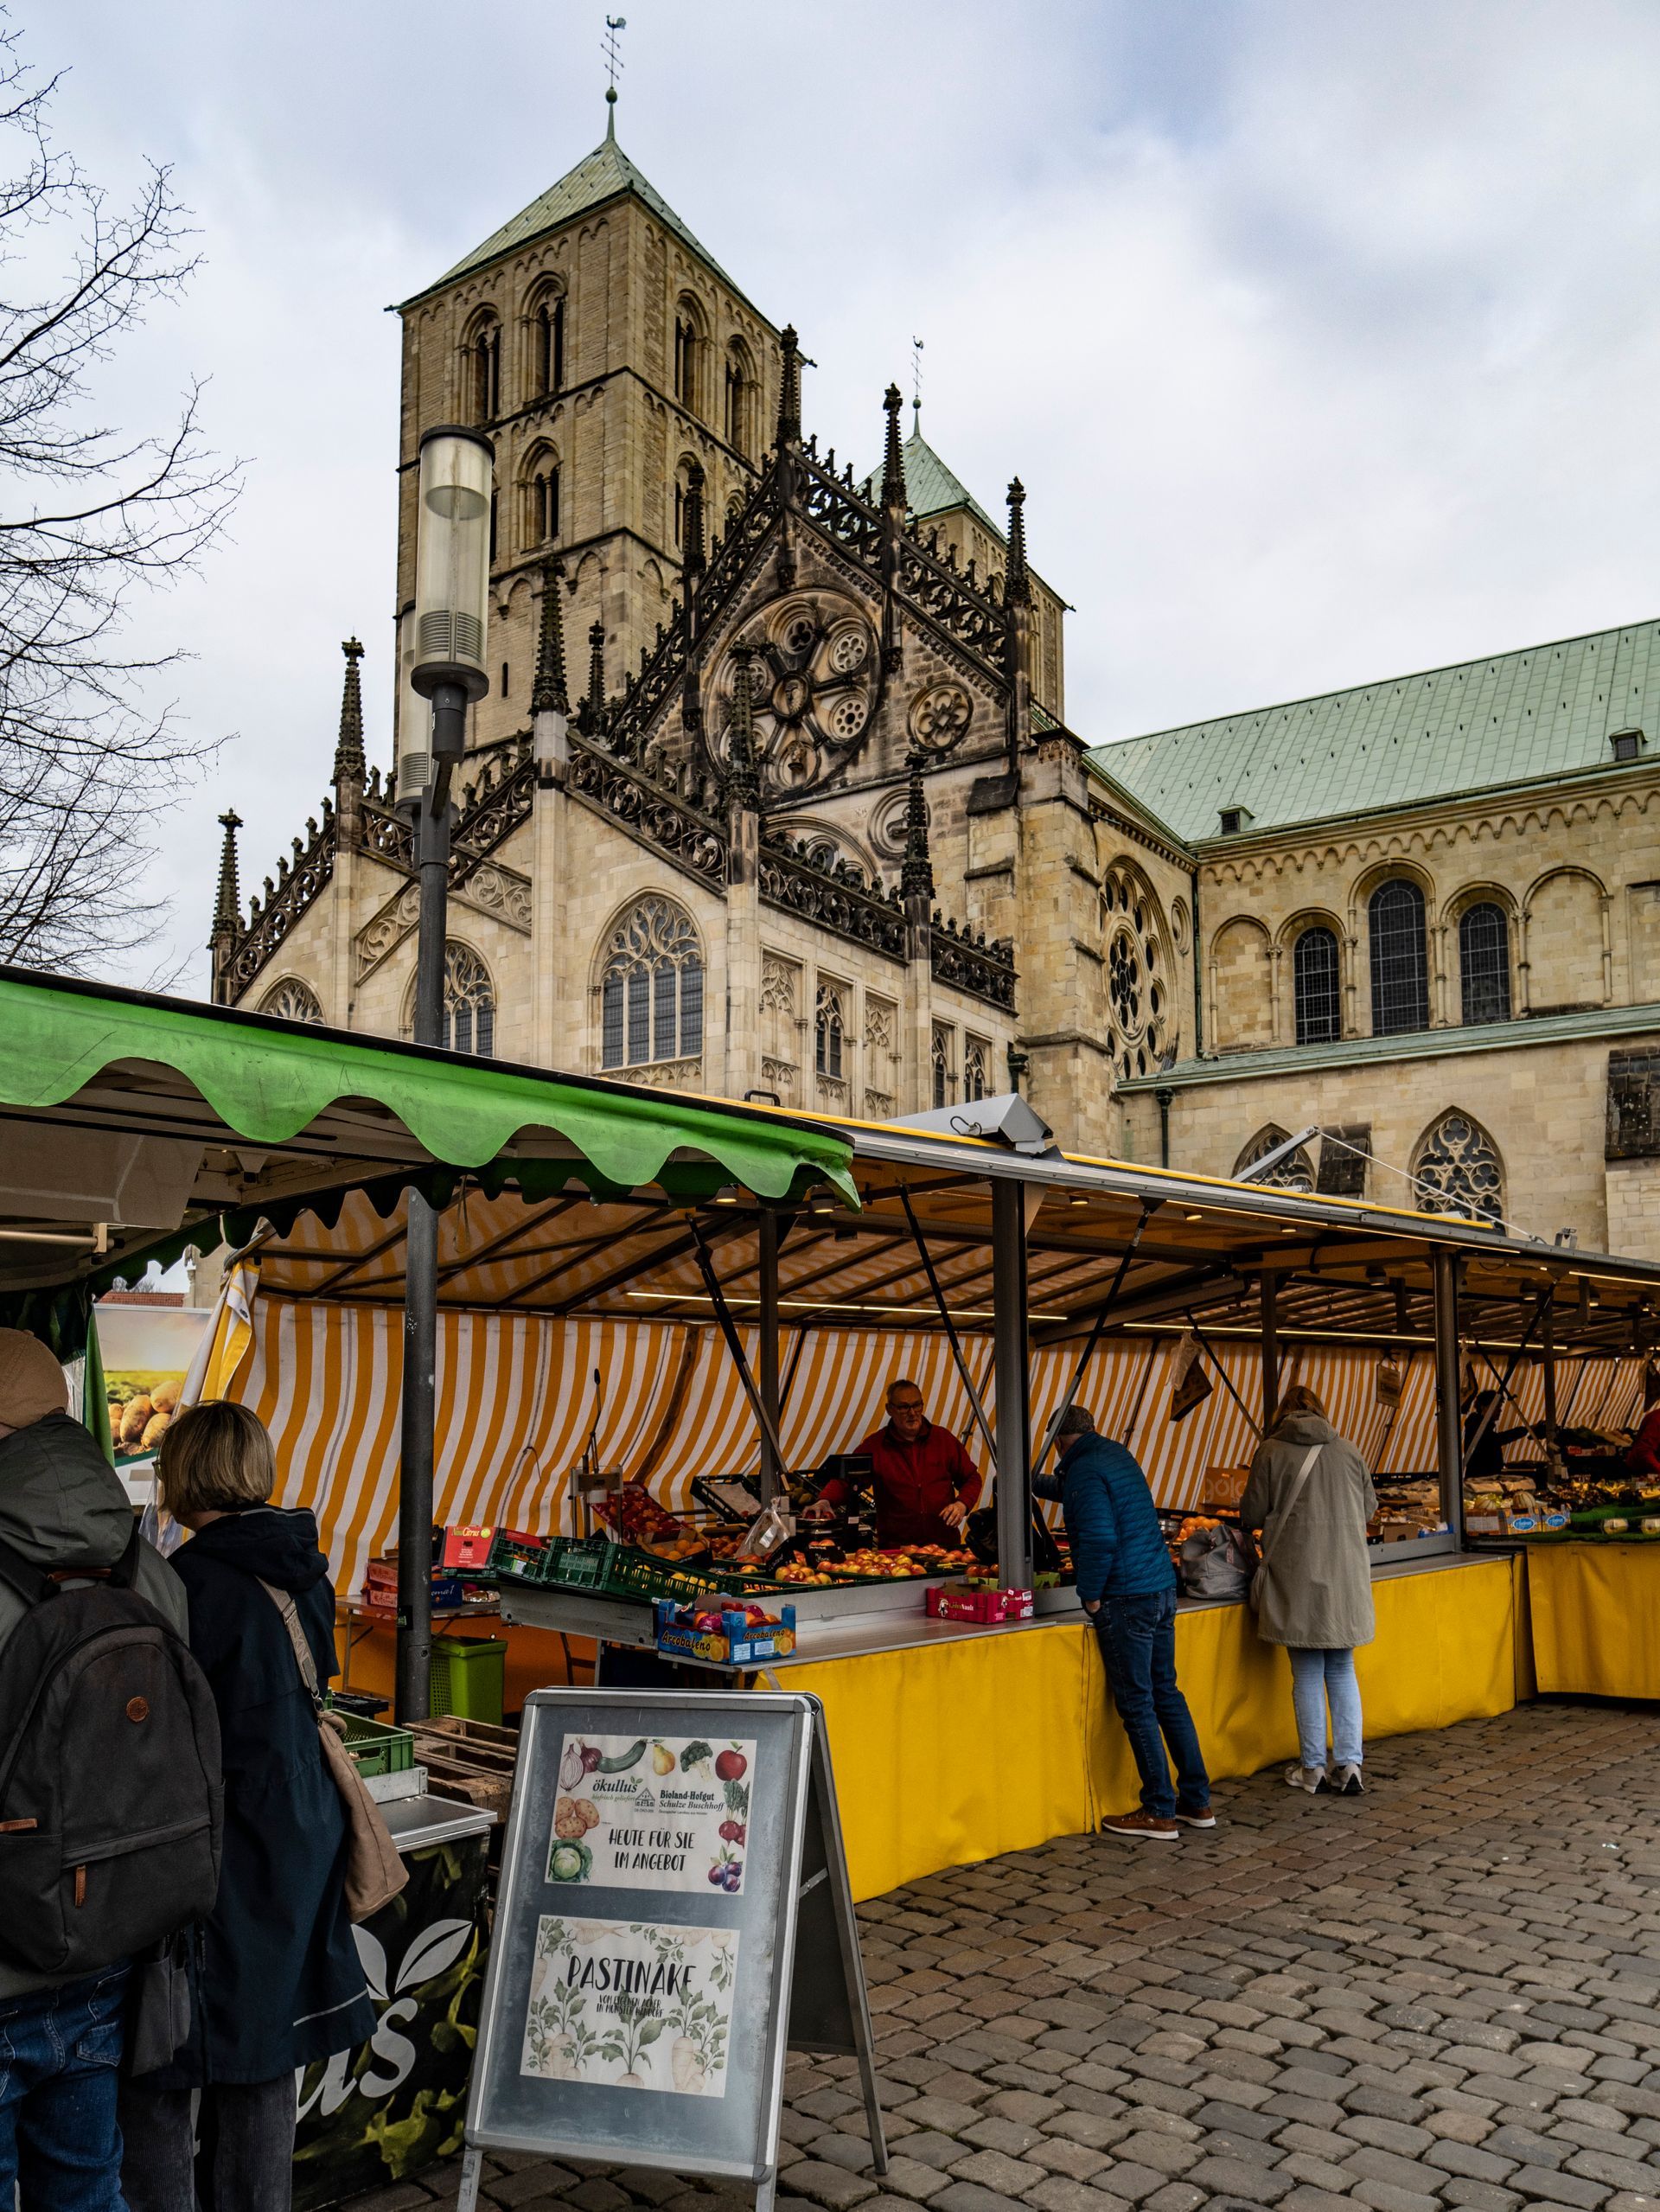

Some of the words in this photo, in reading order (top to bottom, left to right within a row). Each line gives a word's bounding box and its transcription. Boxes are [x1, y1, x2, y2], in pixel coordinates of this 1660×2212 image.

[661, 1631, 711, 1652] Arcobaleno
[744, 1629, 785, 1641] Arcobaleno
[592, 1779, 638, 1793] ökullus
[660, 1789, 714, 1801] Bioland-Hofgut
[659, 1800, 686, 1808] Schulze
[687, 1801, 725, 1812] Buschhoff
[609, 1828, 645, 1846] HEUTE
[648, 1827, 671, 1849] FÜR
[674, 1832, 696, 1850] SIE
[614, 1851, 629, 1870] IM
[632, 1852, 686, 1872] ANGEBOT
[567, 1955, 697, 1996] PASTINAKE
[597, 2003, 603, 2013] IN
[599, 1994, 612, 2004] VOM
[613, 1996, 641, 2007] EIGENEN
[642, 1998, 661, 2009] ACKER
